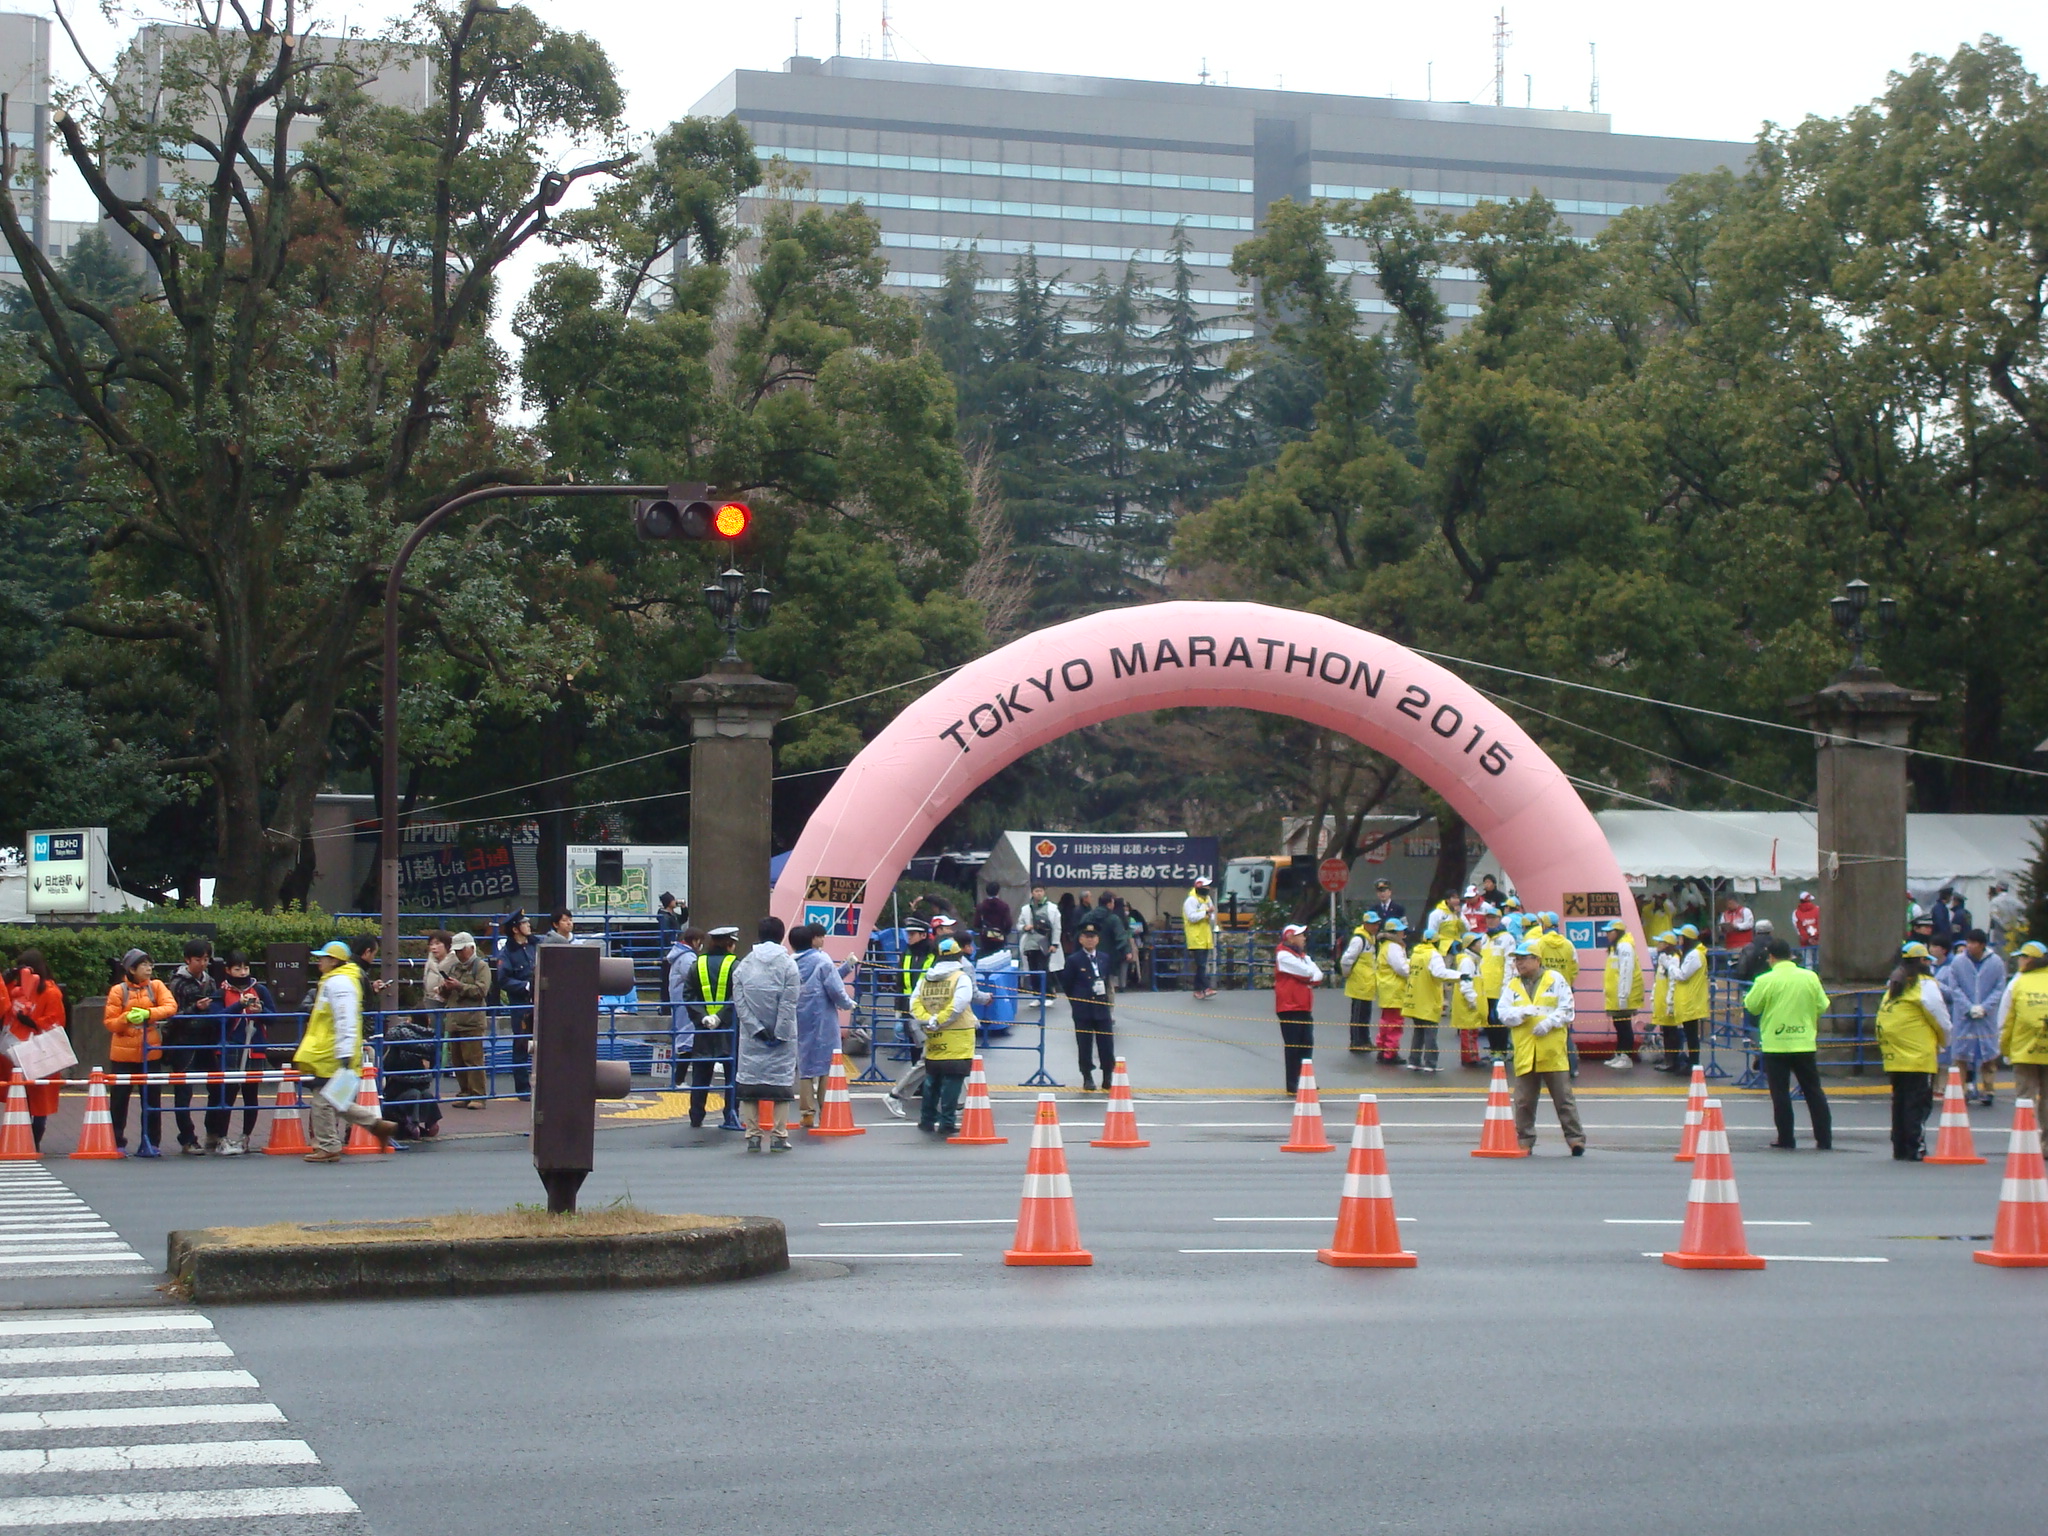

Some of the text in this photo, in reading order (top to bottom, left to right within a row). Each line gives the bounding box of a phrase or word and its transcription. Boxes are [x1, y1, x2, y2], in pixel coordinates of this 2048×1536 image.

[939, 635, 1515, 777] TOKYO MARATHON 2015
[403, 823, 460, 843] IPPON
[1062, 844, 1185, 855] 7 日比谷公園 応援メッセージ
[45, 874, 73, 887] 日比谷駅
[832, 880, 865, 888] TOKYO
